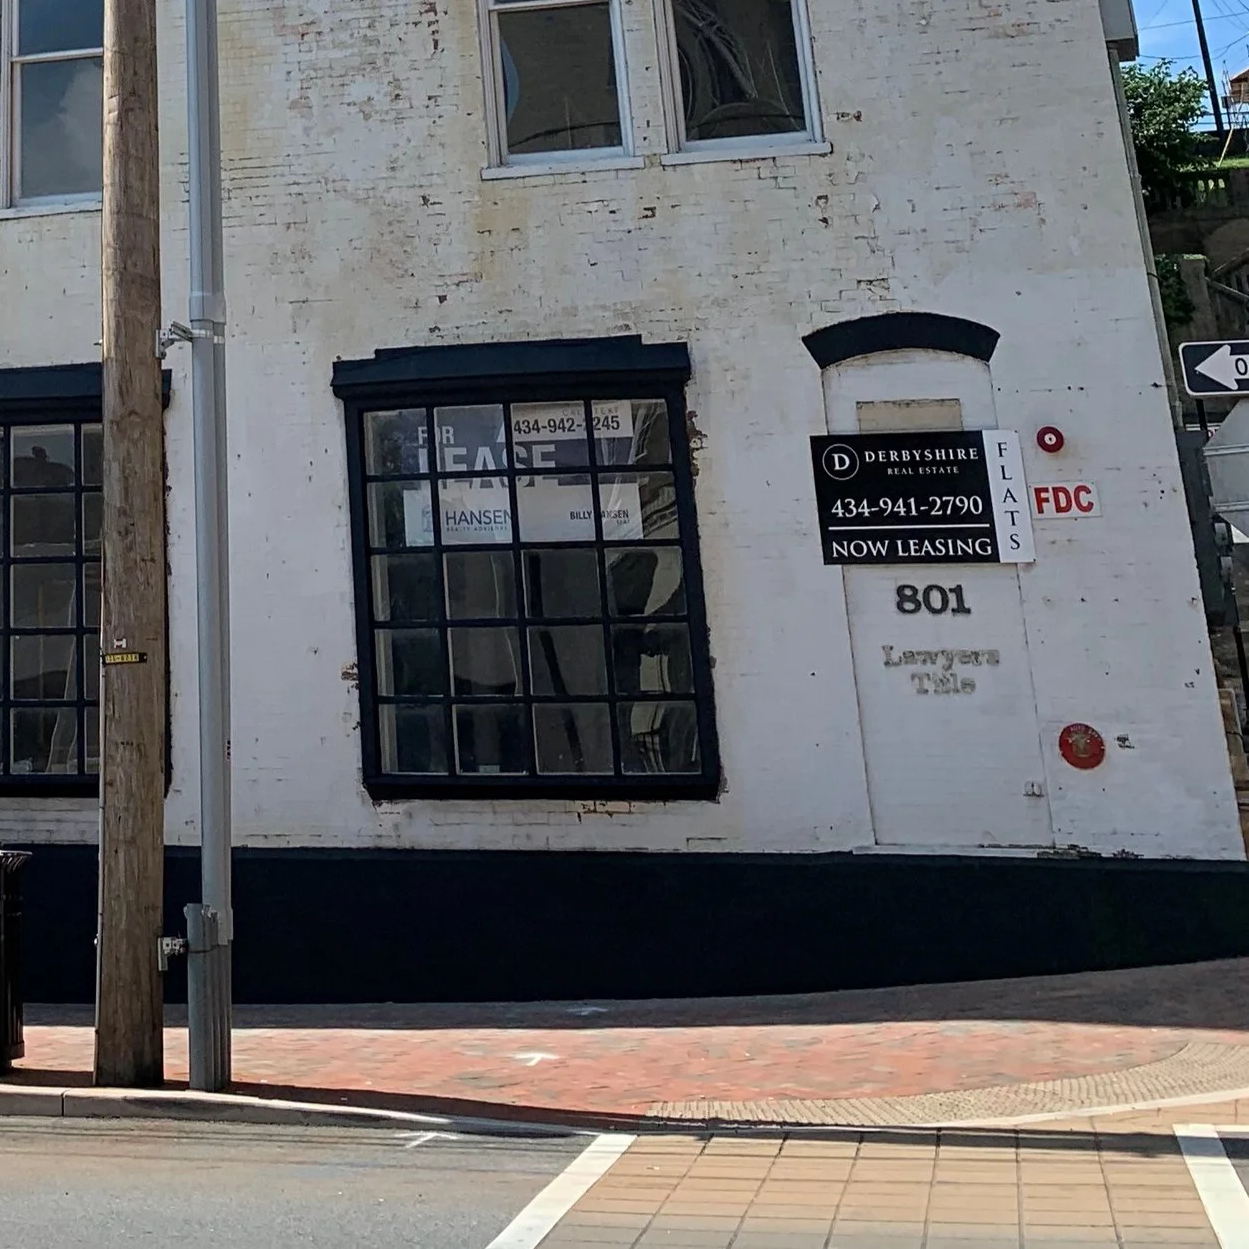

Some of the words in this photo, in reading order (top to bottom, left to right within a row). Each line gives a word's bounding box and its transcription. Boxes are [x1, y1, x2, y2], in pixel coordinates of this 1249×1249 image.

[418, 426, 454, 444] FR
[513, 415, 620, 434] 434-942-245
[831, 453, 850, 471] D
[864, 448, 979, 463] DERBYSHIRE
[887, 467, 914, 475] REAL
[919, 466, 960, 475] ESTATE
[997, 441, 1022, 550] FLATS
[1034, 485, 1094, 514] FDC
[570, 510, 592, 520] BILLY
[600, 510, 629, 519] ANSEN
[831, 495, 983, 518] 434-941-2790
[832, 539, 890, 558] NOW
[896, 538, 992, 557] LEASING
[896, 584, 972, 614] 801
